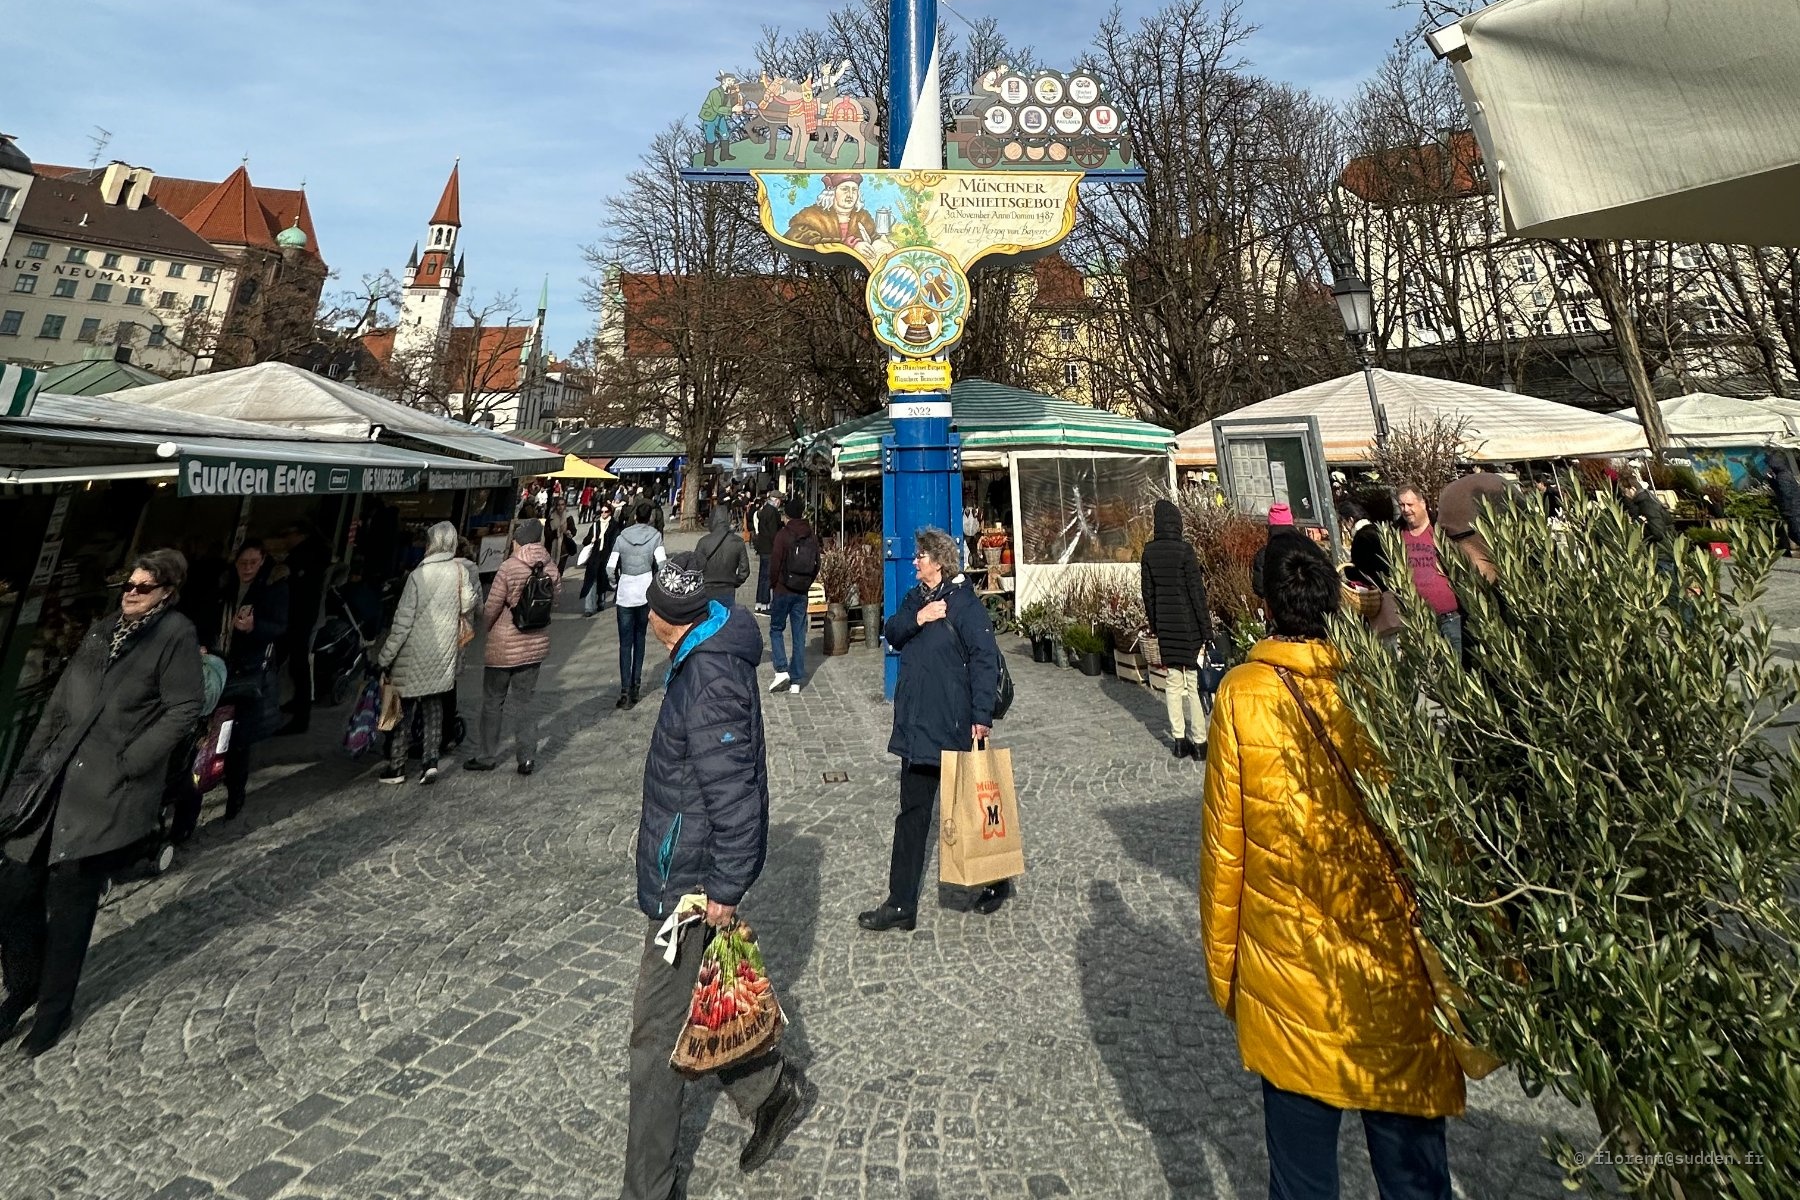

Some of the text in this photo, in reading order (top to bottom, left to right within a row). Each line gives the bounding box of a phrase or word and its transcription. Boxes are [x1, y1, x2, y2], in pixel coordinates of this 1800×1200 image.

[958, 178, 1048, 194] MÜNCHNER
[939, 192, 1062, 210] REINHEITSGEBOT
[956, 209, 990, 220] November
[992, 211, 1011, 220] Anno
[1036, 212, 1055, 224] 1487
[53, 264, 152, 286] NEUMAYR
[908, 406, 931, 416] 2022
[187, 459, 316, 495] Gurken Ecke
[987, 805, 999, 825] M
